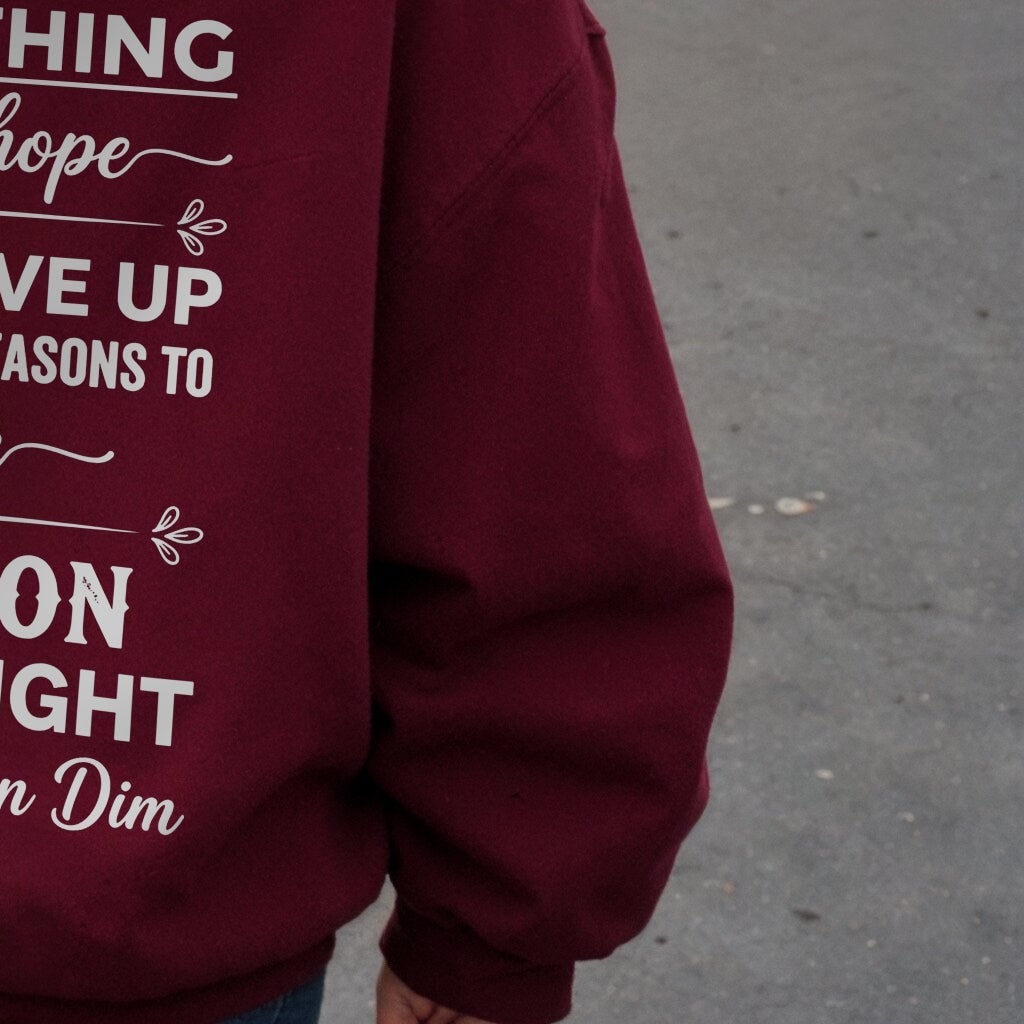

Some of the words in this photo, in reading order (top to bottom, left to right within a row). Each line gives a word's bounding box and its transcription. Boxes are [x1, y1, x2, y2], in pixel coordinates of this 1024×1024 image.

[117, 261, 223, 326] UP
[161, 345, 214, 398] TO
[50, 757, 185, 836] Dim
